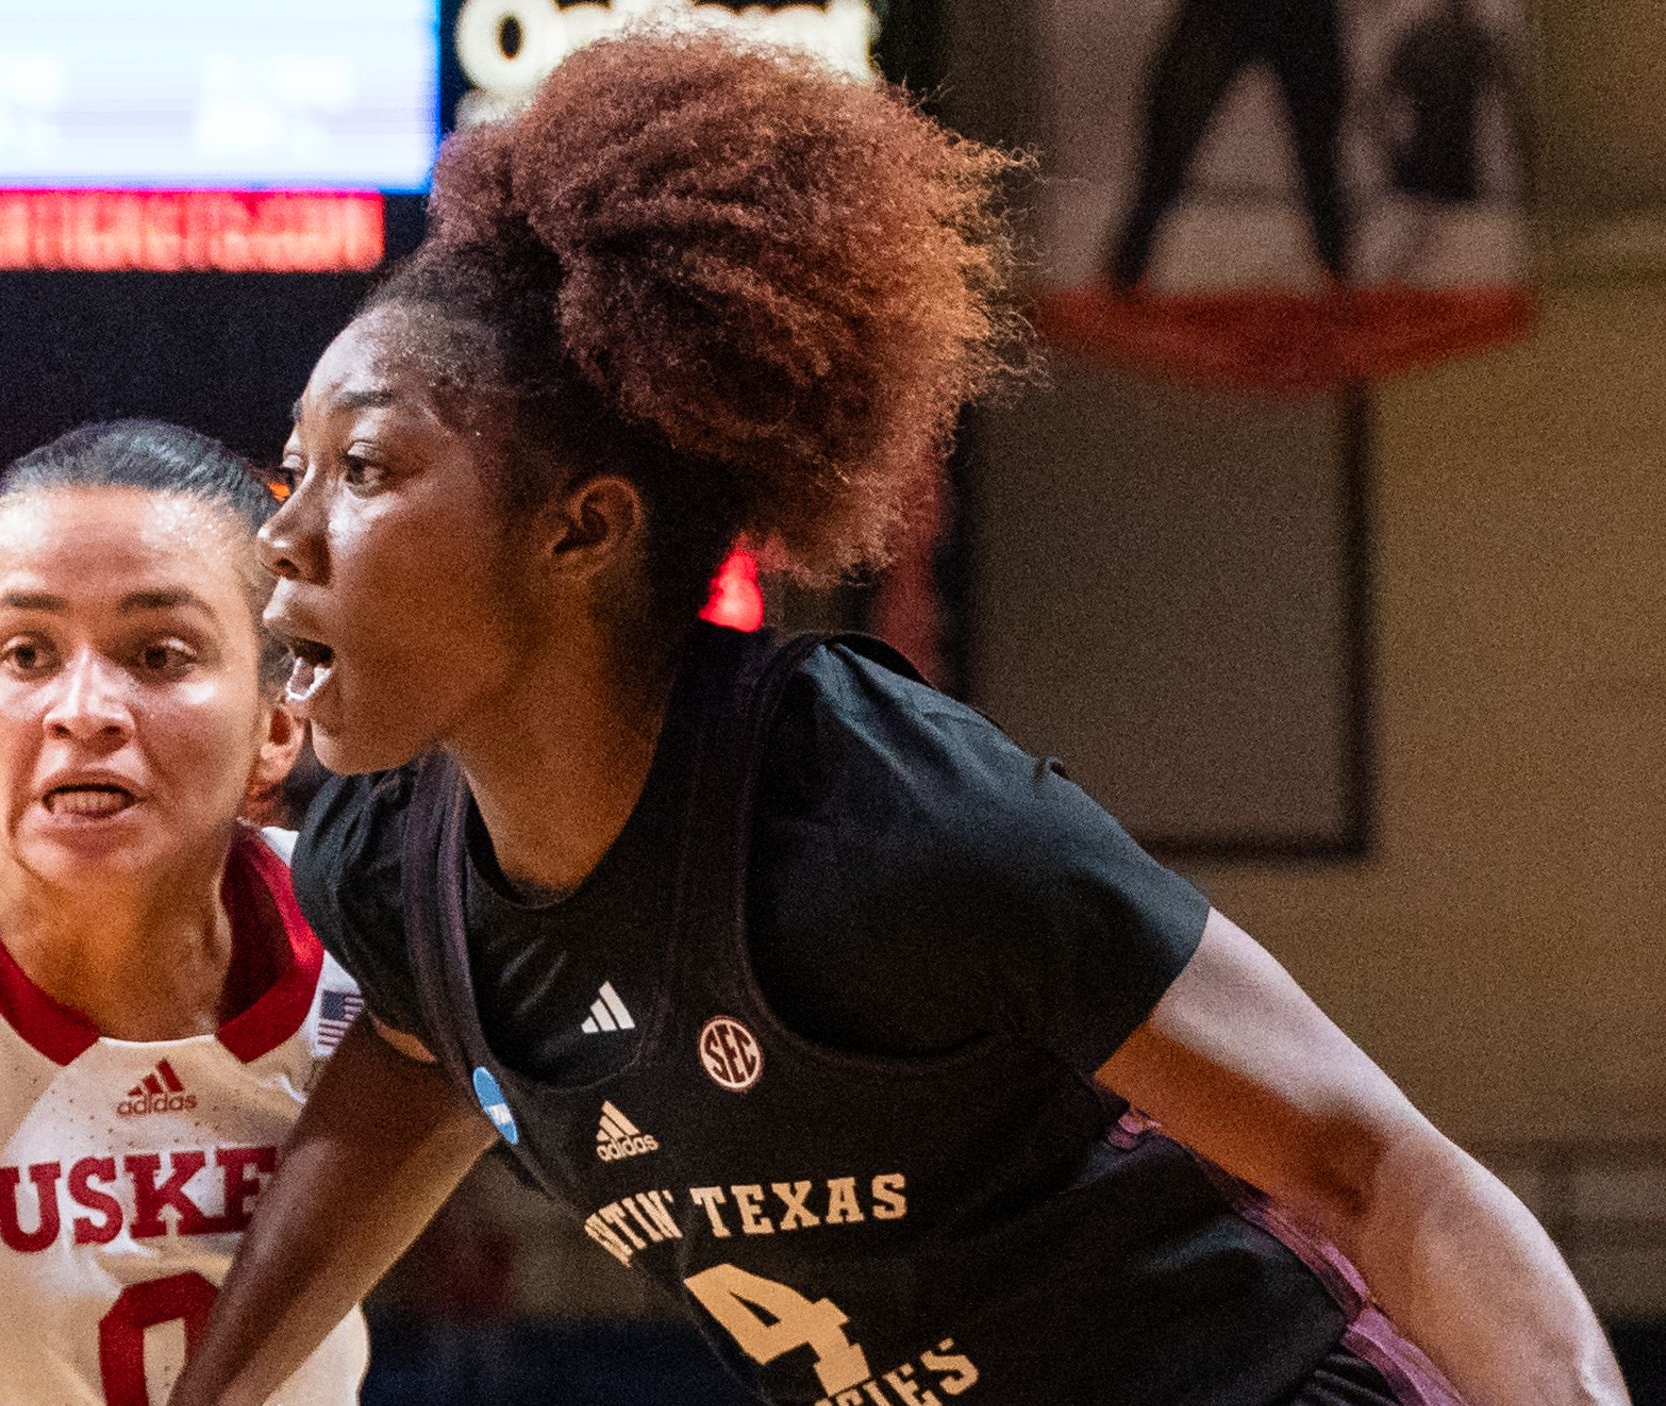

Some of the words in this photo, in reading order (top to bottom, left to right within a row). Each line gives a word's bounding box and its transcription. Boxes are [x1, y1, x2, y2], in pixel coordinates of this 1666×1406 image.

[702, 1020, 760, 1087] SEC
[116, 1091, 197, 1117] adidas
[596, 1134, 659, 1162] adidas
[690, 1172, 908, 1238] TEXAS
[684, 1263, 871, 1397] 4
